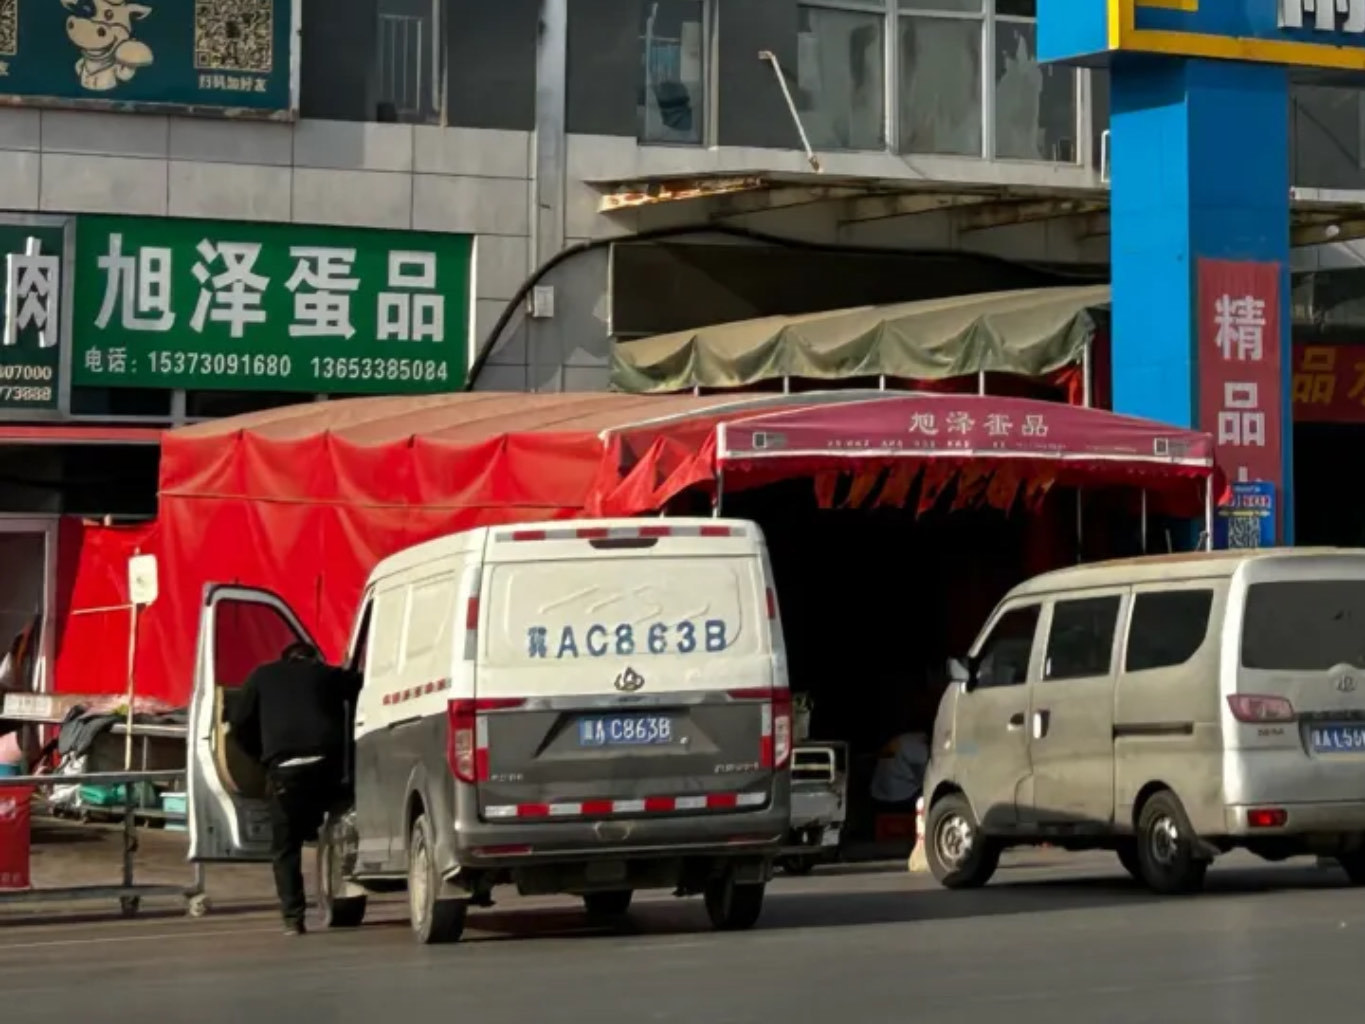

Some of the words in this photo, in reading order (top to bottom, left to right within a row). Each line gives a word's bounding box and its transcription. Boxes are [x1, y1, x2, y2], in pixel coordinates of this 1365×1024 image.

[2, 236, 60, 348] 肉
[94, 233, 446, 342] 旭泽蛋品
[148, 351, 291, 376] 15373091680
[311, 356, 448, 381] 13653385084
[908, 410, 1049, 437] 旭泽蛋品
